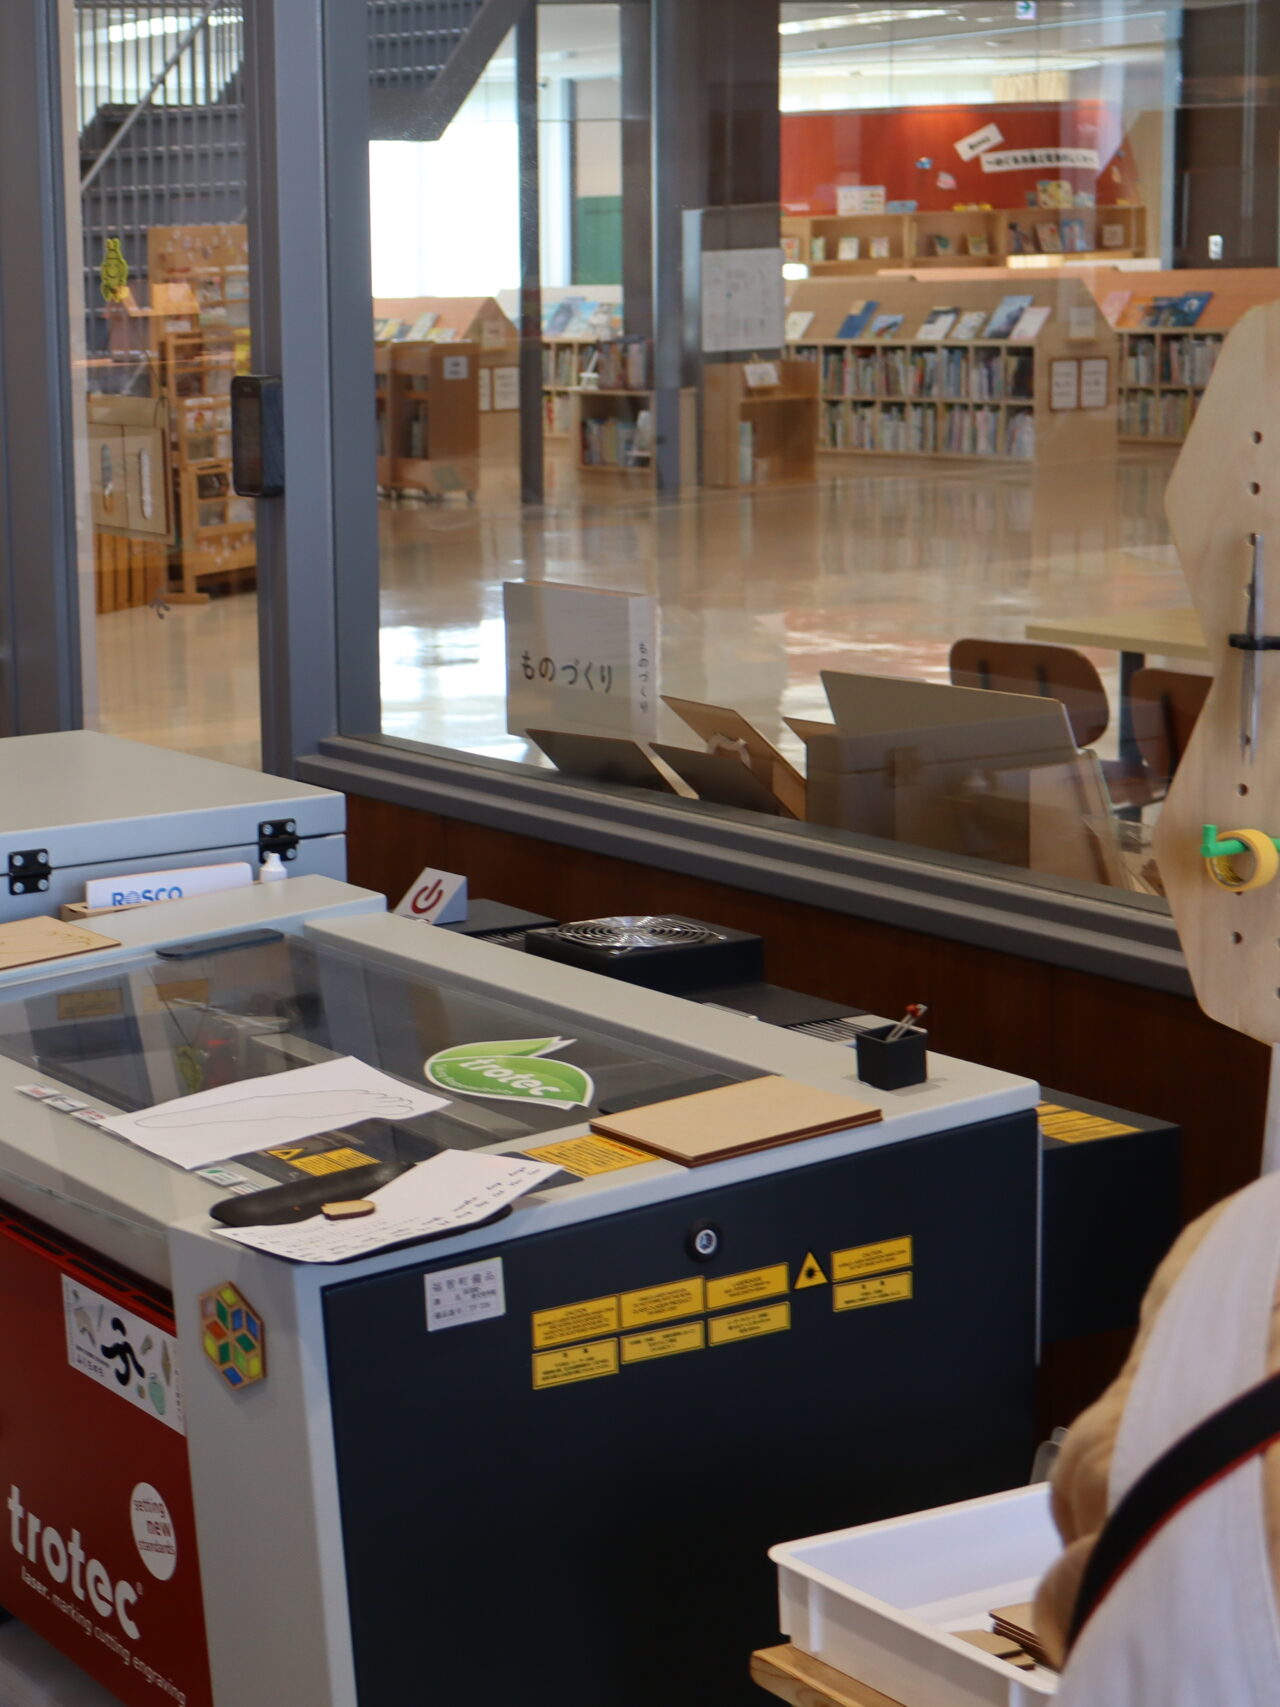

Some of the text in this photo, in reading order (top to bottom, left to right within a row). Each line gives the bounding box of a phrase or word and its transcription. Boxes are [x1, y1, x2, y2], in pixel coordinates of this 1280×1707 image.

[520, 650, 613, 694] ものづくり
[111, 886, 183, 907] ROSCO
[458, 1057, 562, 1097] trotec
[133, 1497, 166, 1519] setting
[146, 1520, 172, 1538] new
[7, 1483, 141, 1640] trotec
[51, 1593, 93, 1637] marking
[94, 1626, 131, 1667] cutting
[132, 1656, 187, 1707] engraving
